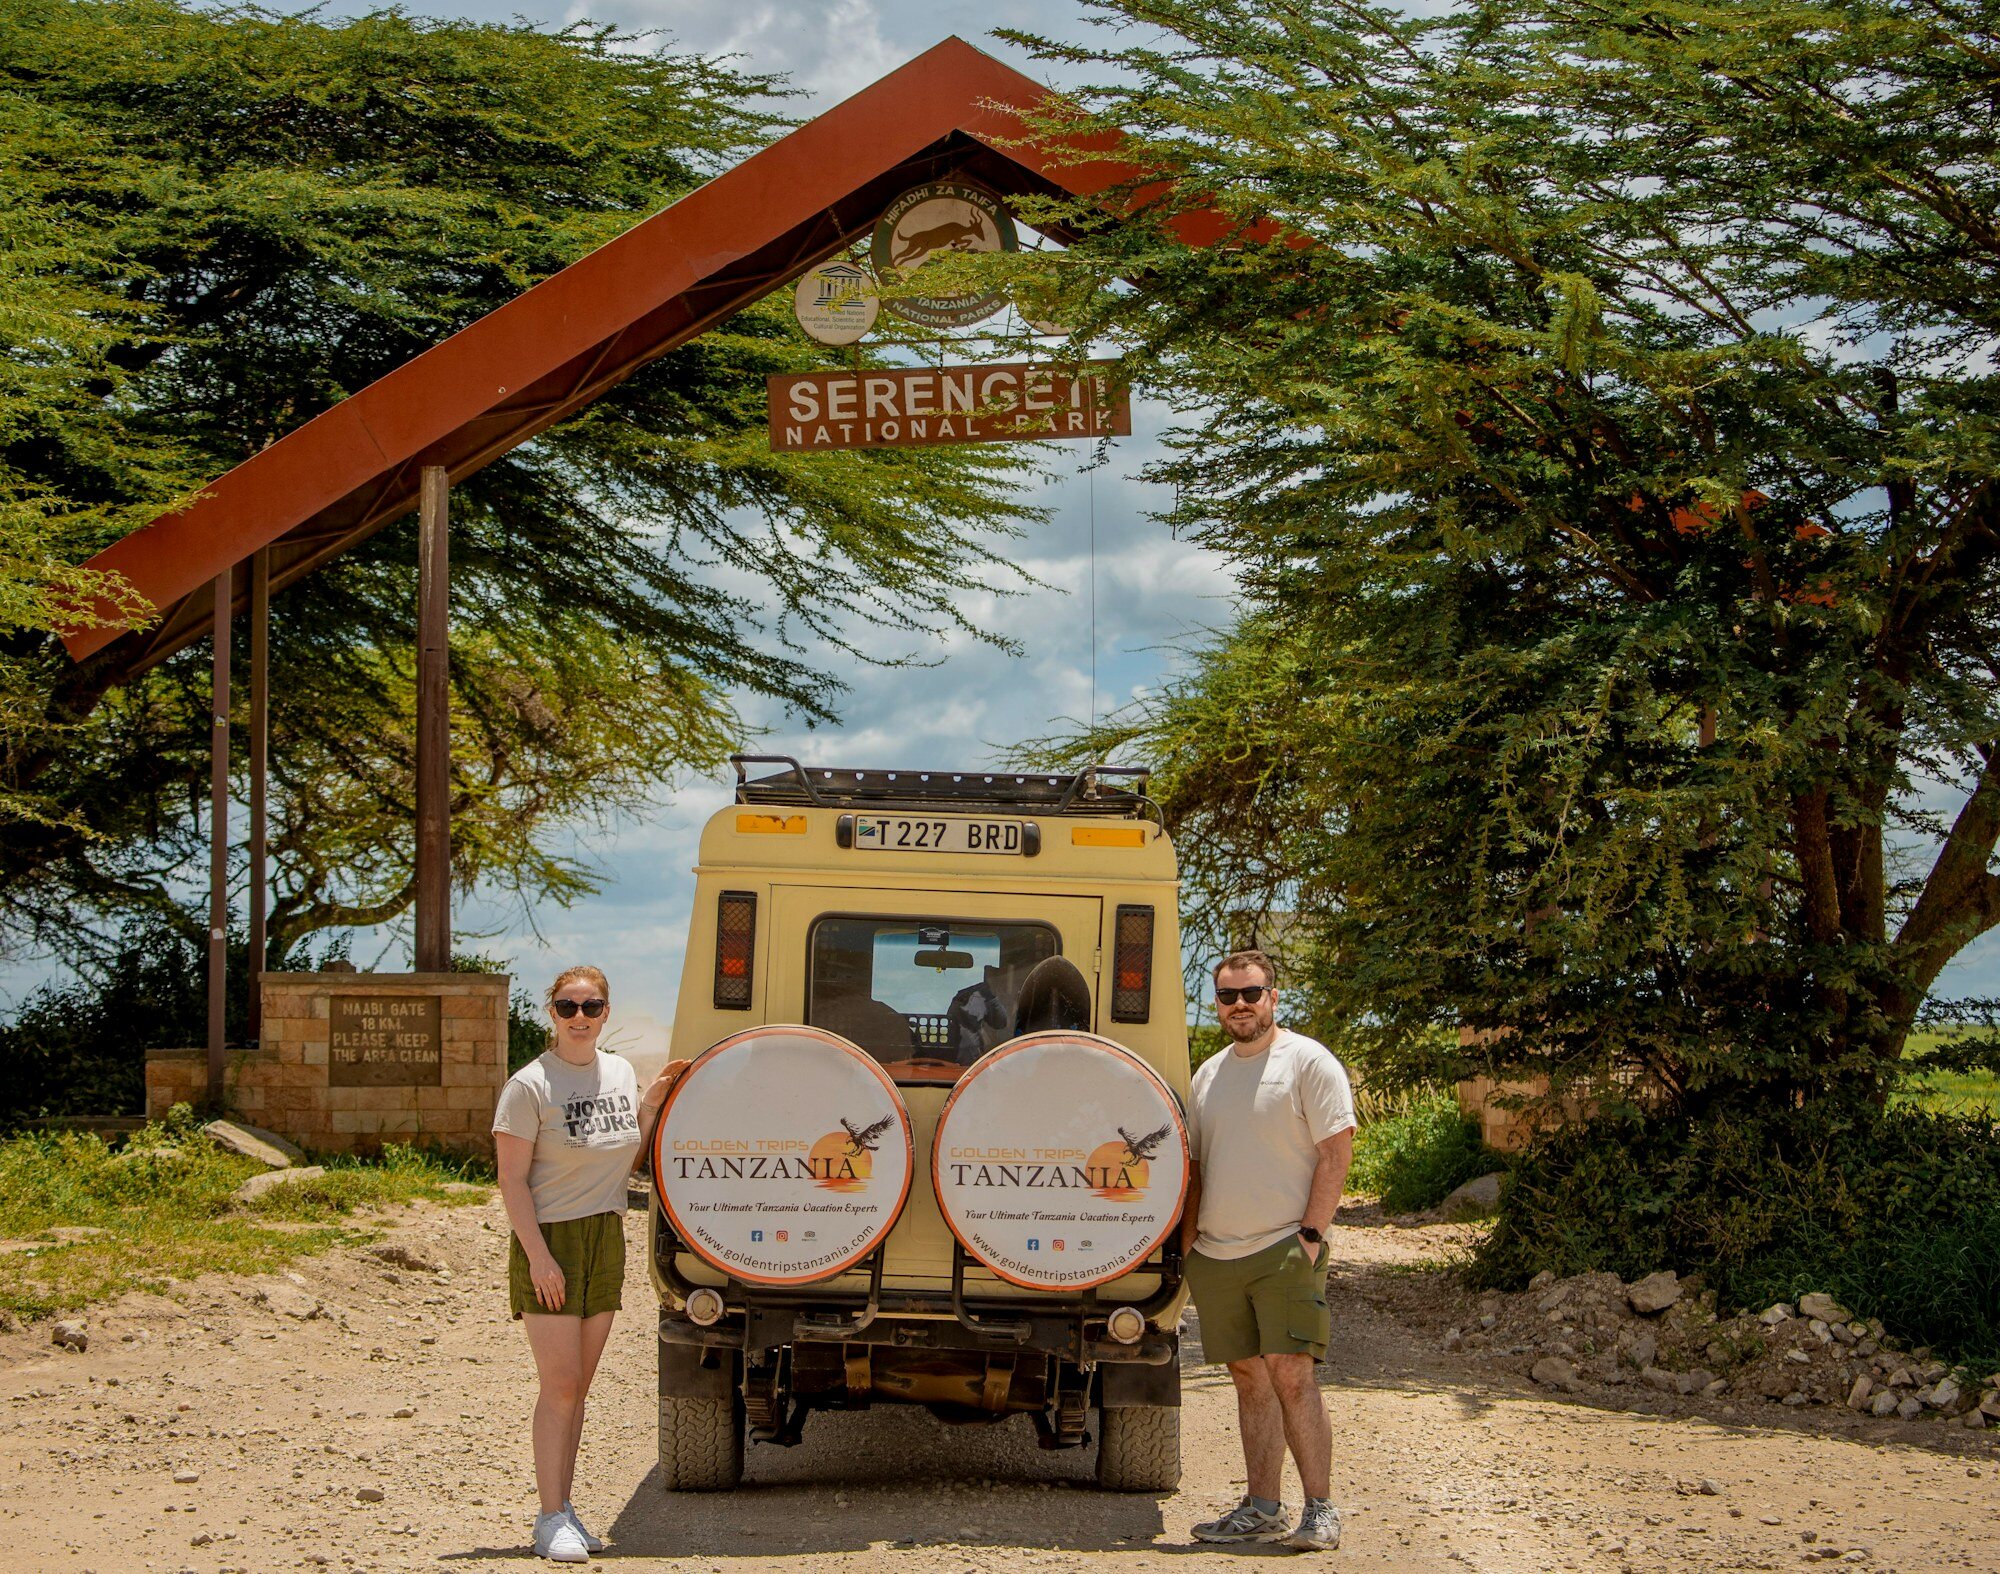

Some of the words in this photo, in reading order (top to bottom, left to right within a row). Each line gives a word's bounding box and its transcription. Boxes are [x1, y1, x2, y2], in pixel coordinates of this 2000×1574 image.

[884, 188, 929, 226] HIFADHI
[935, 185, 955, 196] ZA
[962, 188, 998, 216] TAIFA
[893, 301, 955, 323] NATIONAL
[959, 299, 1001, 323] PARKS
[917, 296, 980, 310] TANZANIA
[786, 417, 981, 445] NATIONAL
[876, 820, 890, 846] T
[897, 821, 947, 848] 227
[967, 823, 1018, 850] BRD
[342, 1003, 383, 1016] NAABI
[390, 1003, 426, 1016] GATE
[361, 1018, 376, 1030] 18
[333, 1032, 387, 1048] PLEASE
[395, 1033, 430, 1048] KEEP
[332, 1048, 357, 1062] THE
[363, 1049, 396, 1062] AREA
[400, 1050, 439, 1063] CLEAN
[673, 1140, 749, 1151] GOLDEN
[755, 1140, 809, 1151] TRIPS
[950, 1147, 1026, 1159] GOLDEN
[1032, 1149, 1086, 1160] TRIPS
[673, 1157, 859, 1179] TANZANIA
[950, 1164, 1135, 1189] TANZANIA
[688, 1202, 711, 1212] Your
[713, 1202, 753, 1212] Ultimate
[754, 1202, 799, 1212] Tanzania
[803, 1202, 843, 1213] Vacation
[844, 1203, 878, 1215] Experts
[965, 1210, 987, 1220] Your
[989, 1210, 1030, 1220] Ultimate
[1031, 1211, 1076, 1221] Tanzania
[1079, 1212, 1120, 1222] Vacation
[1121, 1213, 1155, 1225] Experts
[696, 1224, 875, 1273] www.goldentripstanzania.com
[972, 1233, 1151, 1283] www.goldentripstanzania.com
